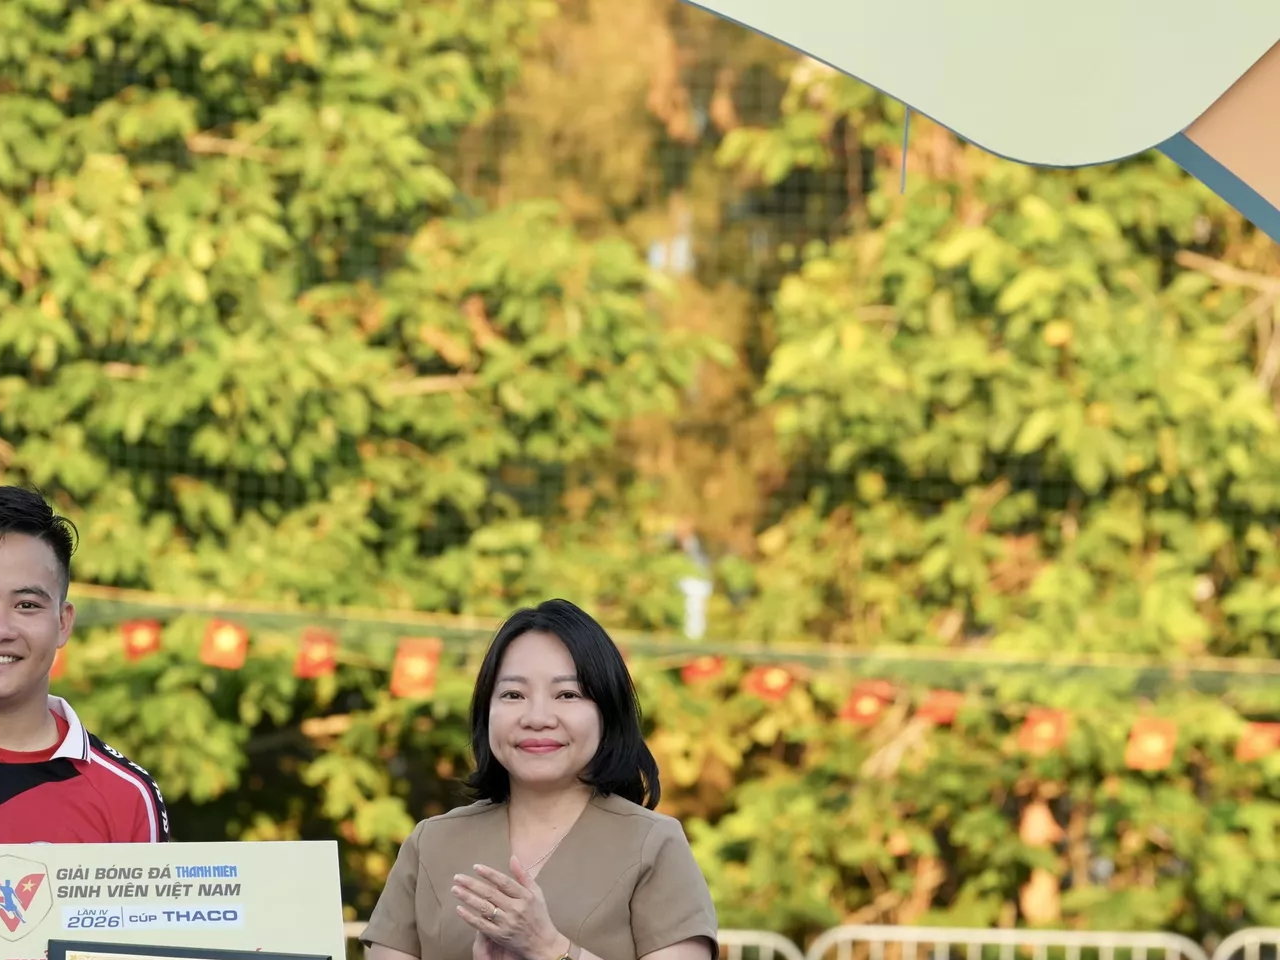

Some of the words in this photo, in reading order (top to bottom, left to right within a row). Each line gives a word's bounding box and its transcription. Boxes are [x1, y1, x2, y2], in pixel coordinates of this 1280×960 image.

[56, 865, 90, 880] GIẢI
[94, 865, 143, 880] BÓNG
[148, 864, 171, 879] ĐÁ
[57, 885, 101, 898] SINH
[107, 882, 149, 897] VIÊN
[155, 882, 193, 900] VIỆT
[198, 883, 241, 896] NAM
[67, 916, 120, 928] 2026
[129, 913, 157, 922] CÚP
[162, 910, 238, 922] THACO
